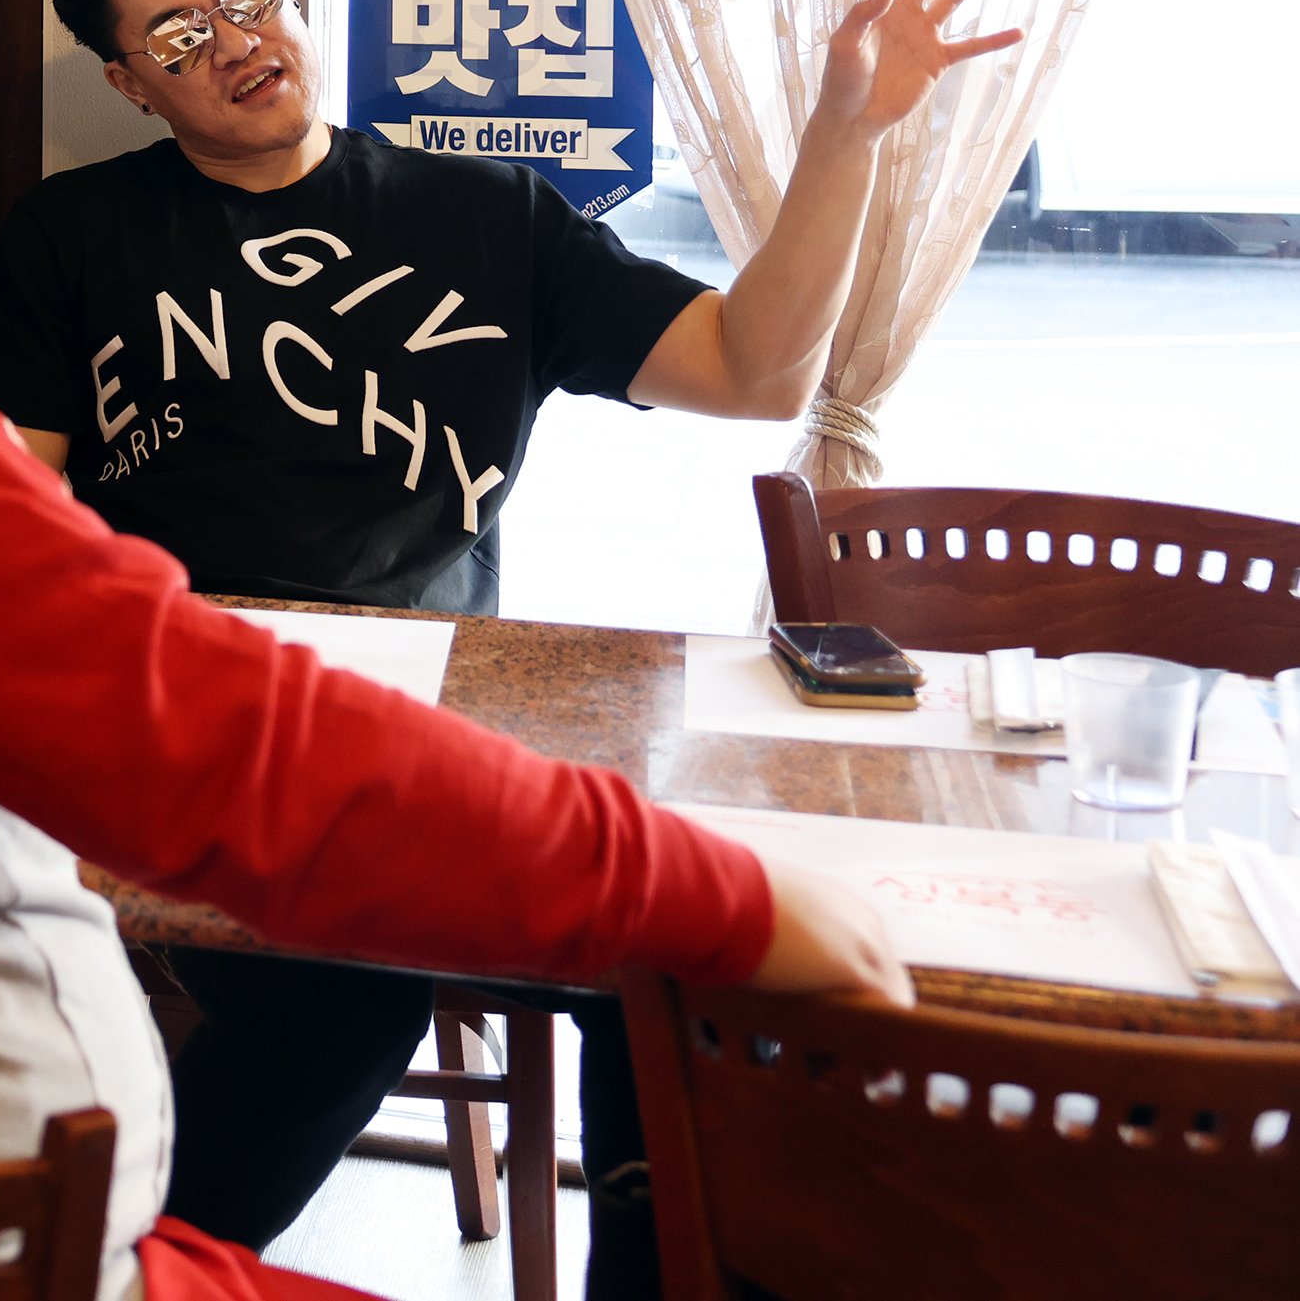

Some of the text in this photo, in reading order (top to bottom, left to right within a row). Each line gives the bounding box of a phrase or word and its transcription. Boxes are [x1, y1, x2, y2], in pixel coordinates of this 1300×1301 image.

[419, 120, 582, 154] We deliver
[98, 402, 184, 482] PARIS
